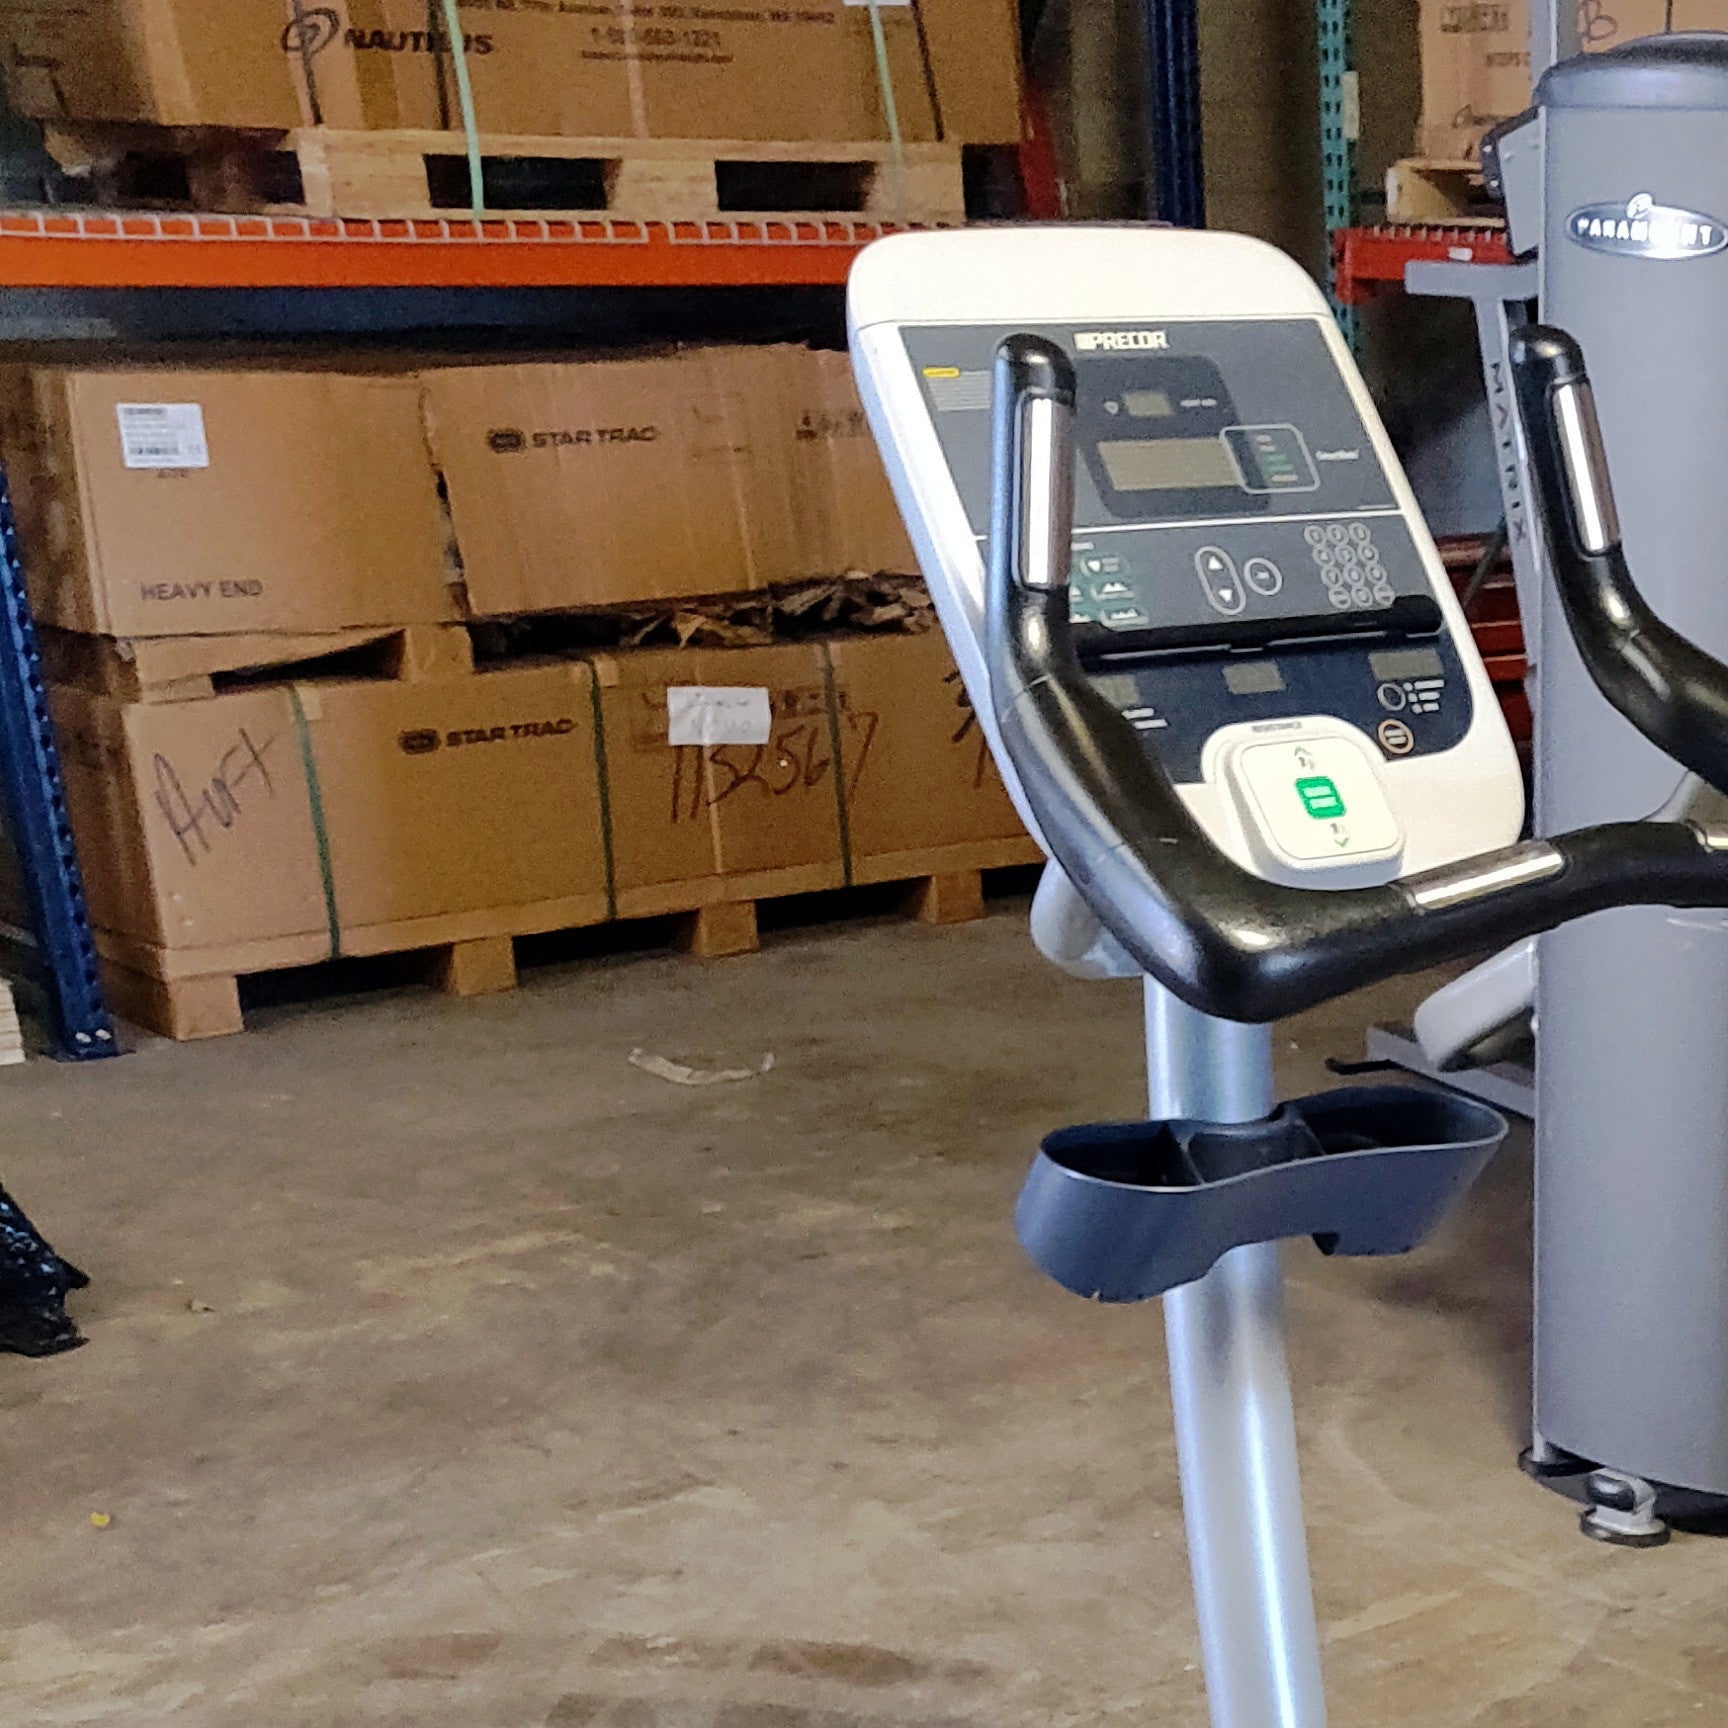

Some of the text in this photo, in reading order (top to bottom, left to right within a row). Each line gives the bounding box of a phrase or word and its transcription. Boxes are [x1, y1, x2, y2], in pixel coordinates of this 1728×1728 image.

[1577, 217, 1713, 247] PARAMNT
[1090, 331, 1170, 350] PRECOR
[140, 579, 263, 601] HEAVY END
[446, 727, 506, 747] STAR
